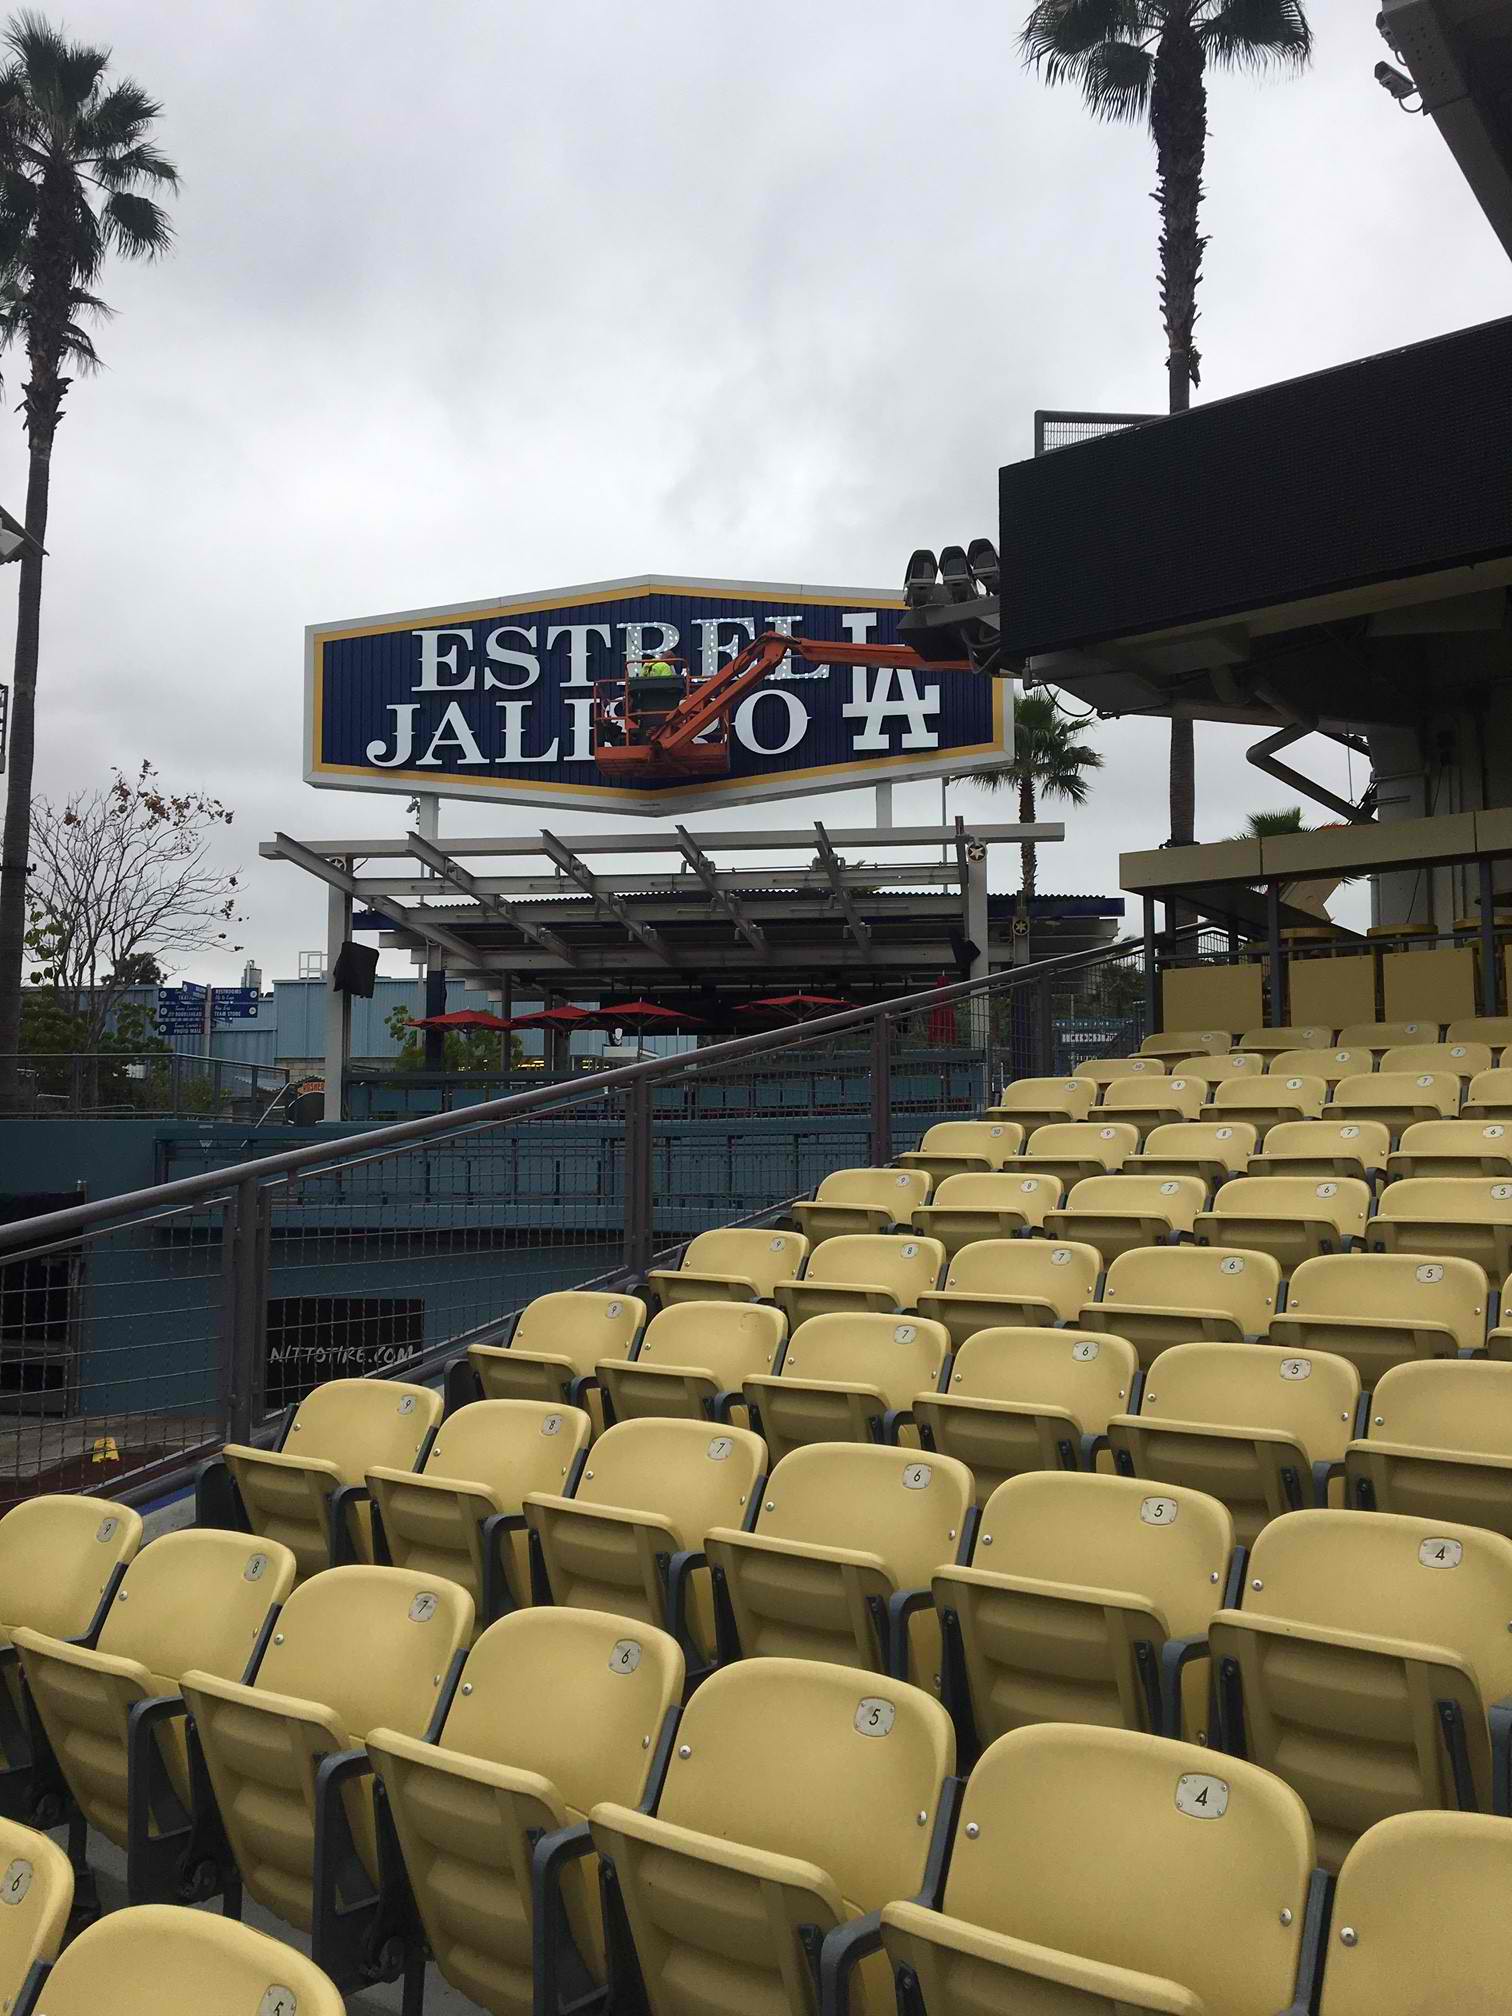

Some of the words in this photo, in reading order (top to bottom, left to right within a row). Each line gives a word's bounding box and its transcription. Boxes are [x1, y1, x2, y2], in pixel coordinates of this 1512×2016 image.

[366, 689, 812, 768] JALIO
[1059, 1253, 1065, 1261] 7
[1426, 1269, 1433, 1278] 5
[902, 1330, 909, 1339] 7
[269, 1345, 413, 1364] NITTOTIRE.COM
[1083, 1347, 1089, 1356] 6
[1292, 1364, 1300, 1374] 5
[404, 1399, 412, 1408] 9
[548, 1420, 556, 1430] 8
[716, 1443, 725, 1453] 7
[913, 1470, 921, 1481] 6
[1154, 1504, 1164, 1517] 5
[104, 1524, 111, 1535] 9
[1435, 1546, 1445, 1560] 4
[251, 1561, 260, 1574] 8
[418, 1600, 428, 1614] 7
[621, 1649, 631, 1663] 6
[869, 1708, 880, 1725] 5
[1195, 1786, 1208, 1806] 4
[11, 1873, 23, 1891] 6
